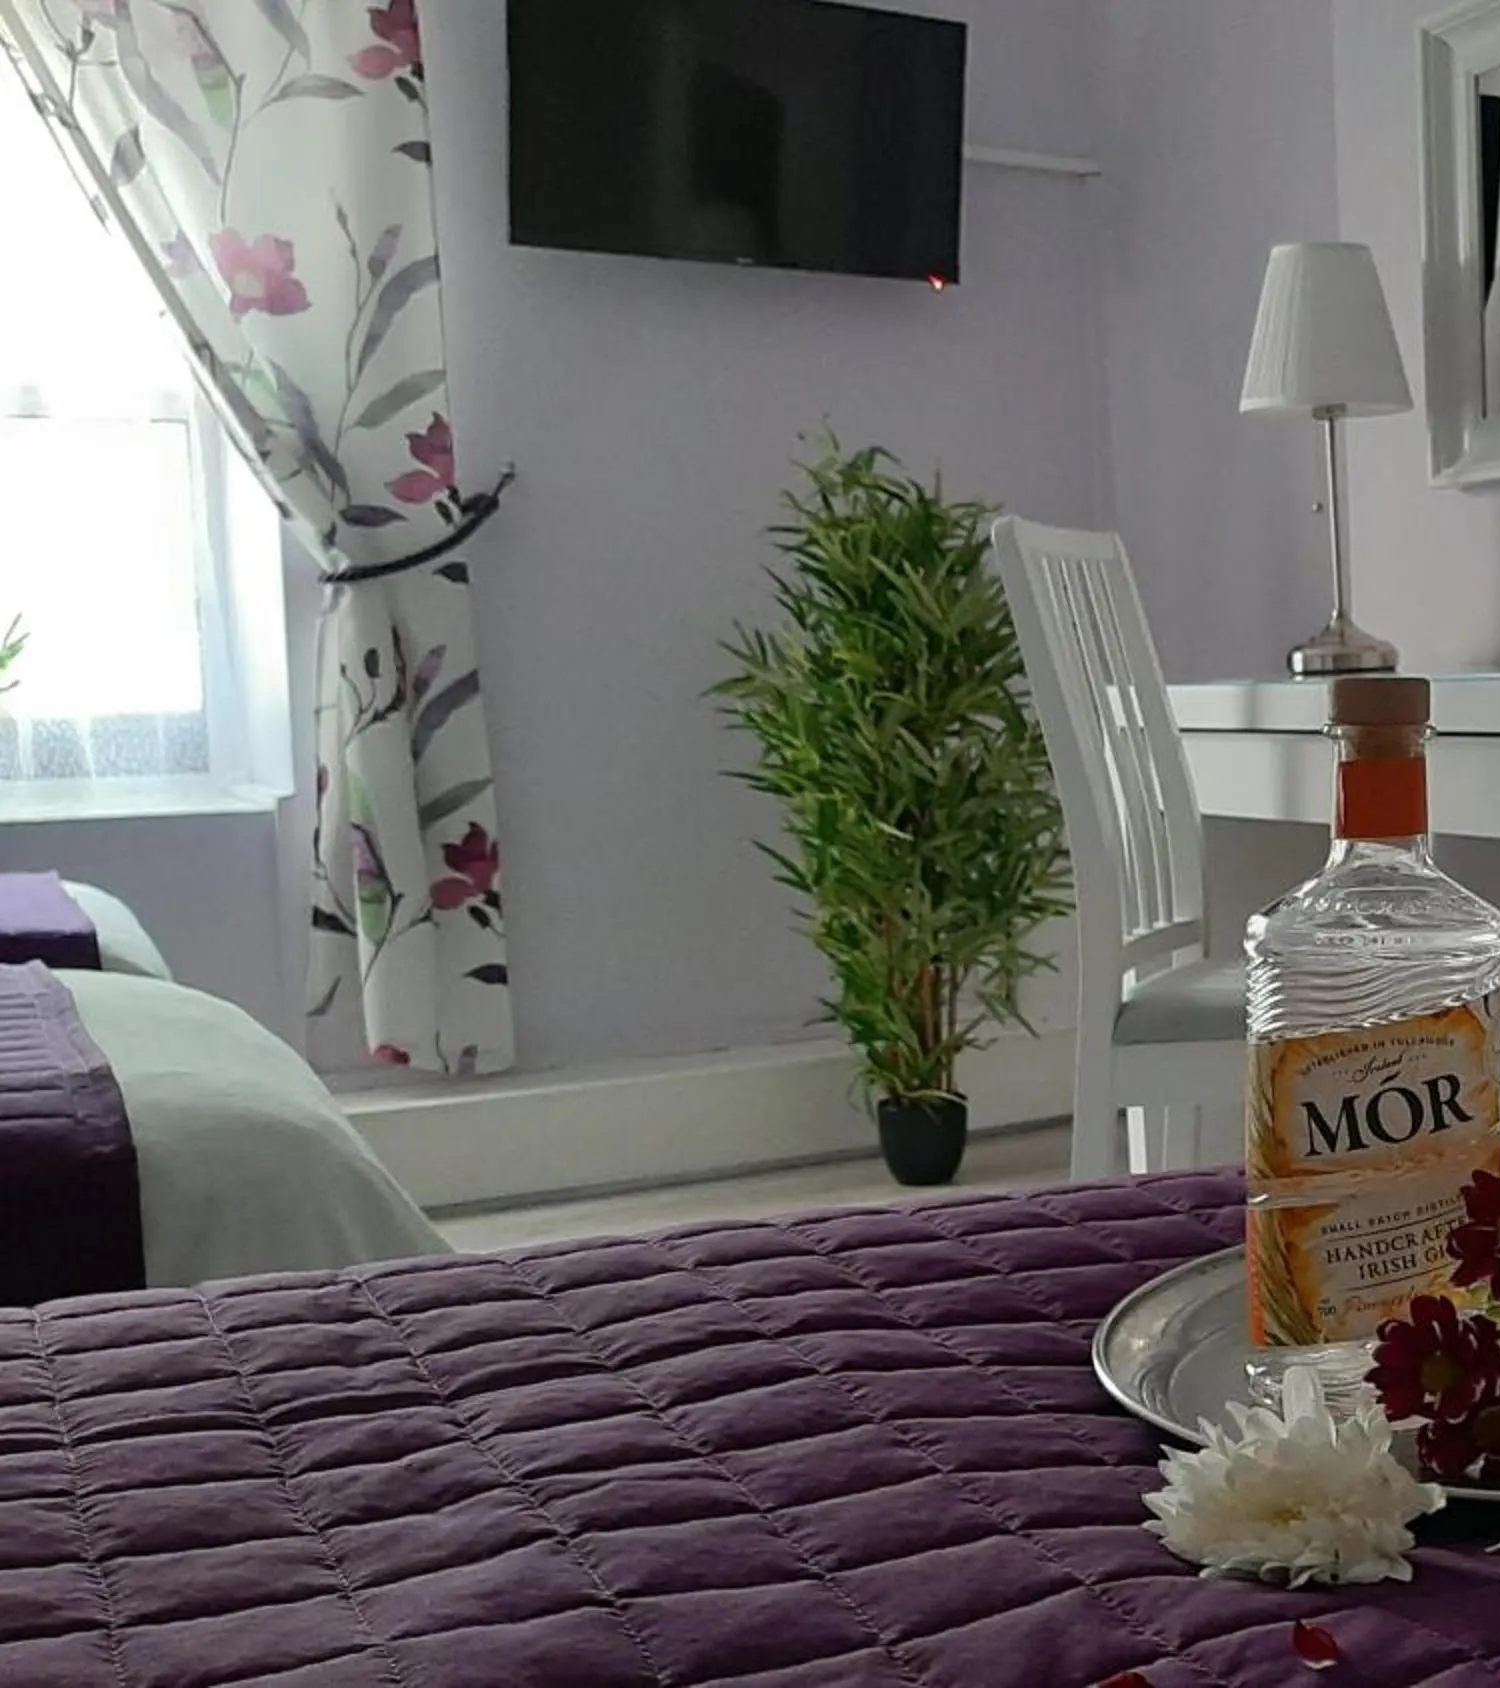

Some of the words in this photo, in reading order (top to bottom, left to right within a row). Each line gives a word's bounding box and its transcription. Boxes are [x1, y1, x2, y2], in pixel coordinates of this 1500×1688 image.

[1302, 1073, 1474, 1157] MÓR
[1358, 1253, 1418, 1281] IRISH
[1424, 1244, 1446, 1264] GI
